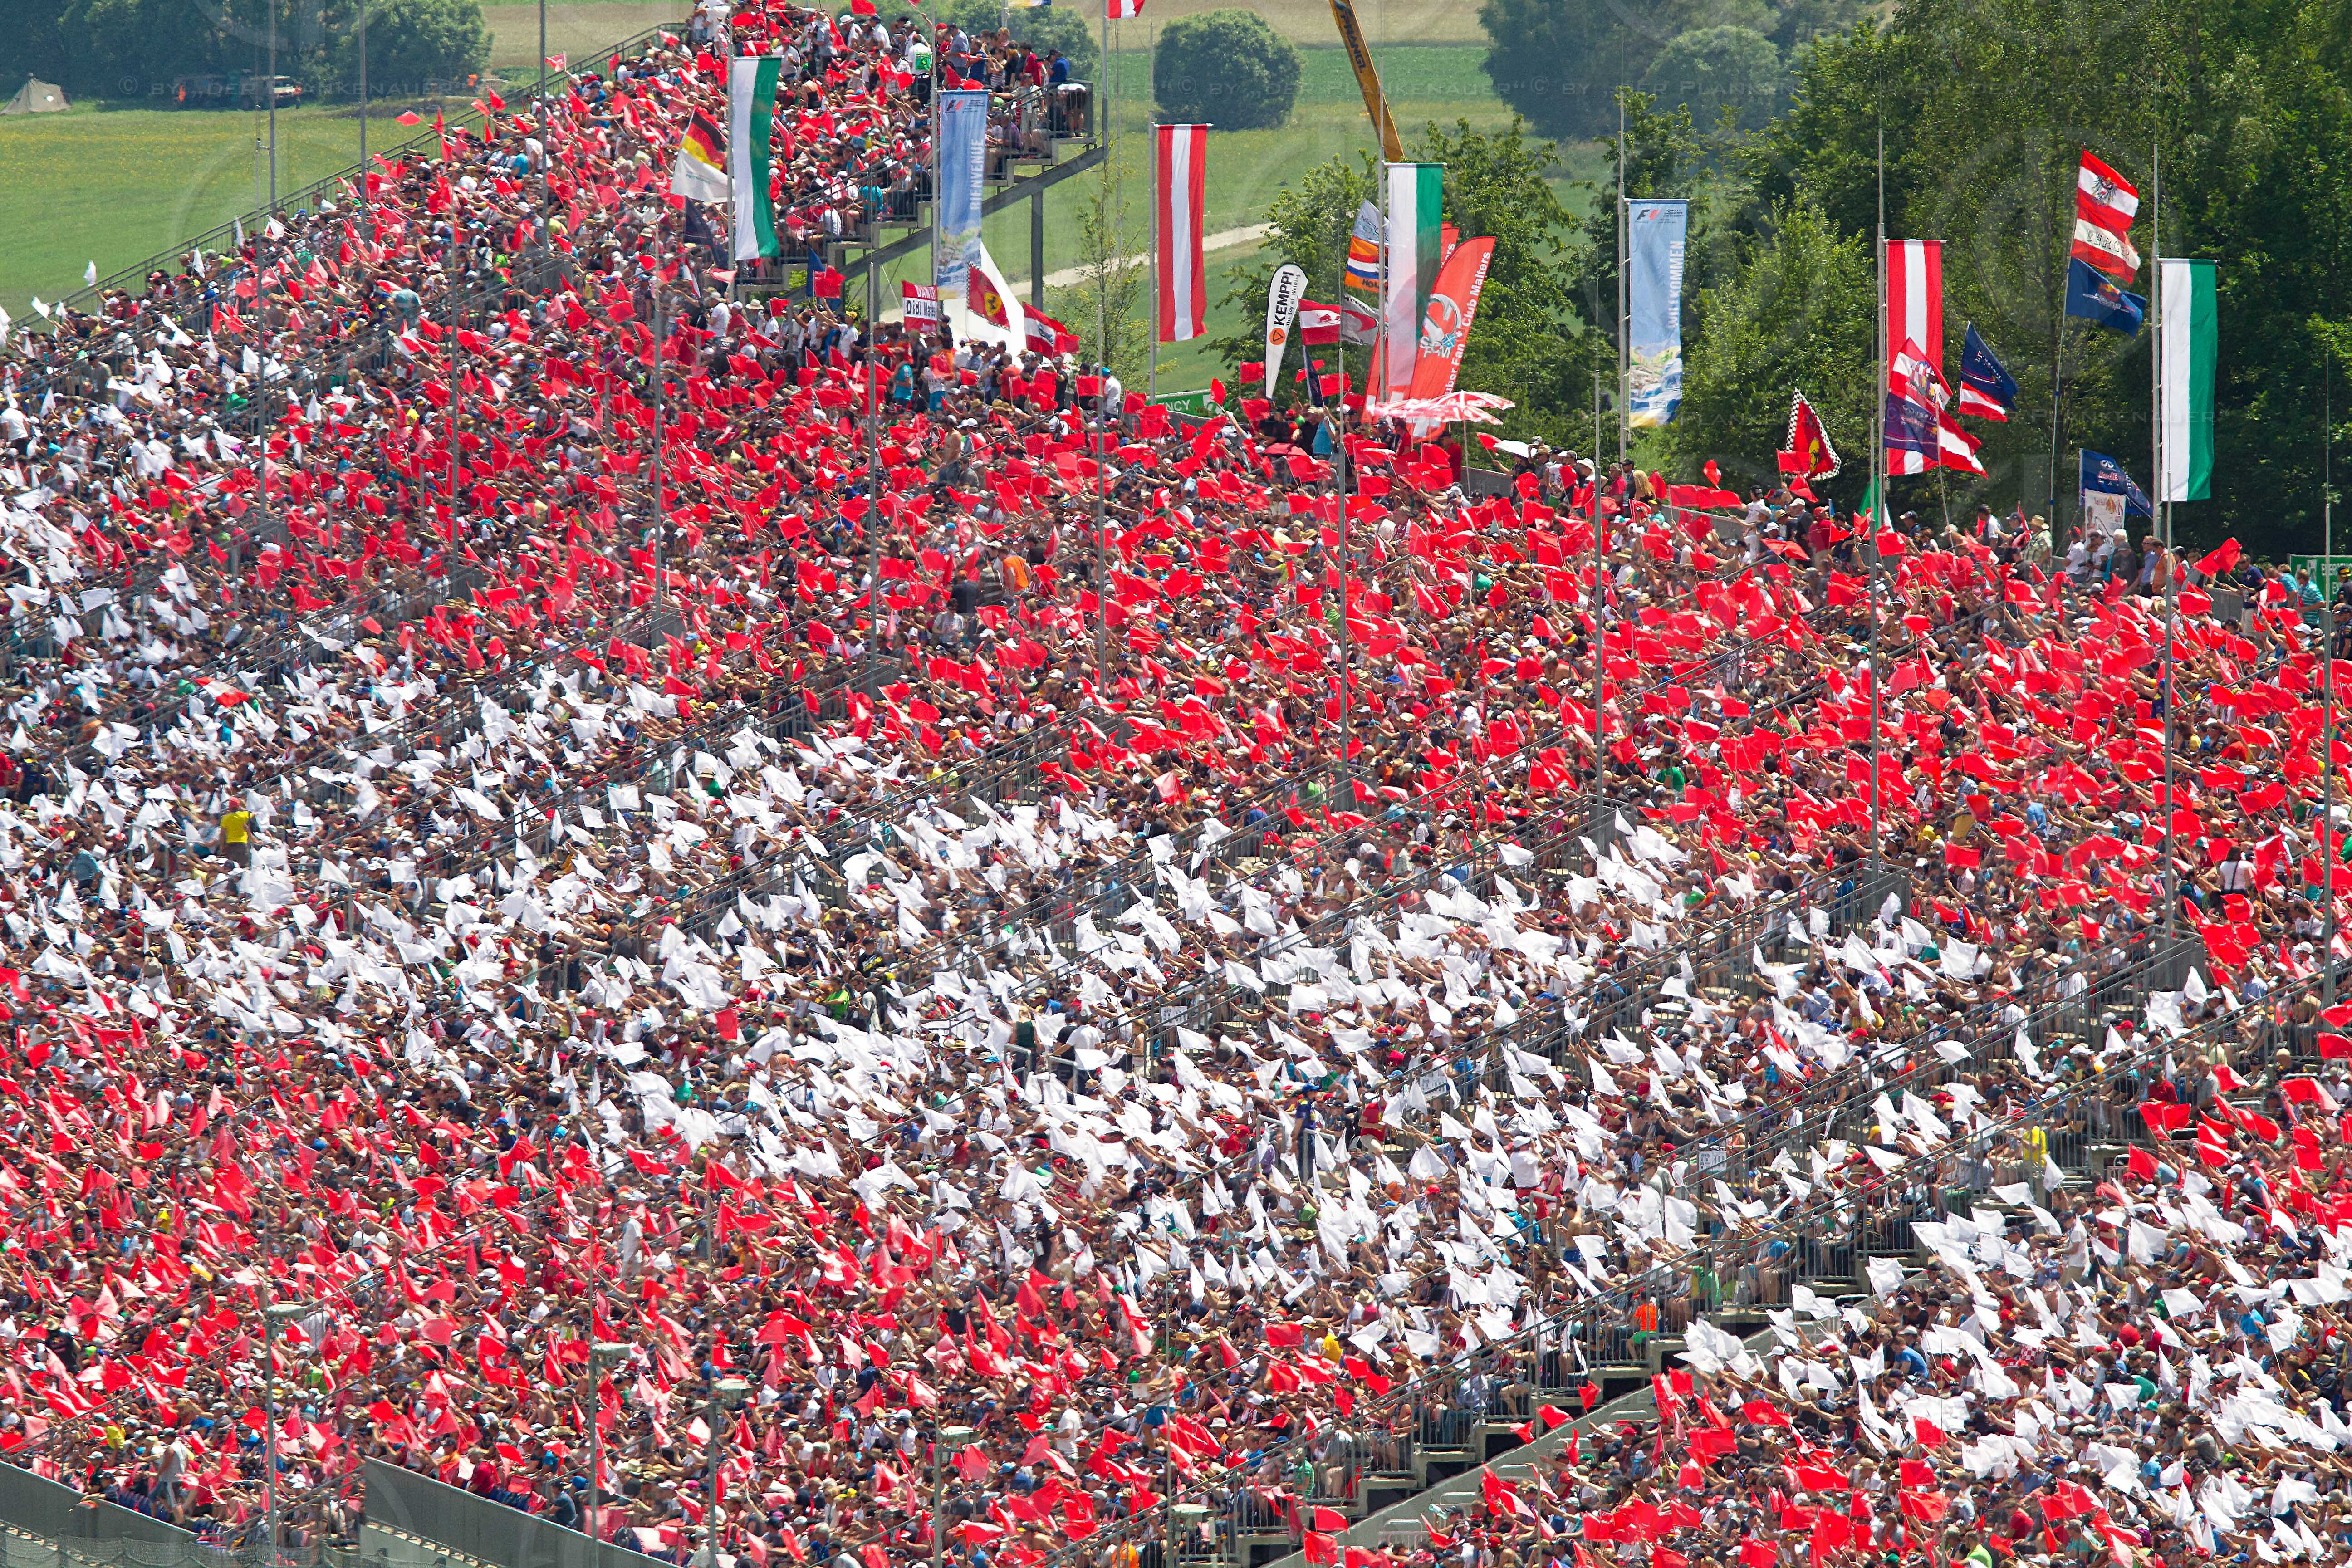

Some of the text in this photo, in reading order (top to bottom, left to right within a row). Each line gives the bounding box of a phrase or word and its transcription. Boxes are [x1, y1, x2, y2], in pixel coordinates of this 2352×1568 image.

[970, 139, 984, 211] BIENVENUE
[906, 300, 921, 315] Didi
[1274, 271, 1294, 325] KEMPPI
[1451, 343, 1465, 366] Fan
[1462, 299, 1477, 327] Club
[1470, 252, 1491, 296] Malters
[1668, 240, 1684, 329] WILLKOMMEN
[1165, 399, 1190, 411] NCY
